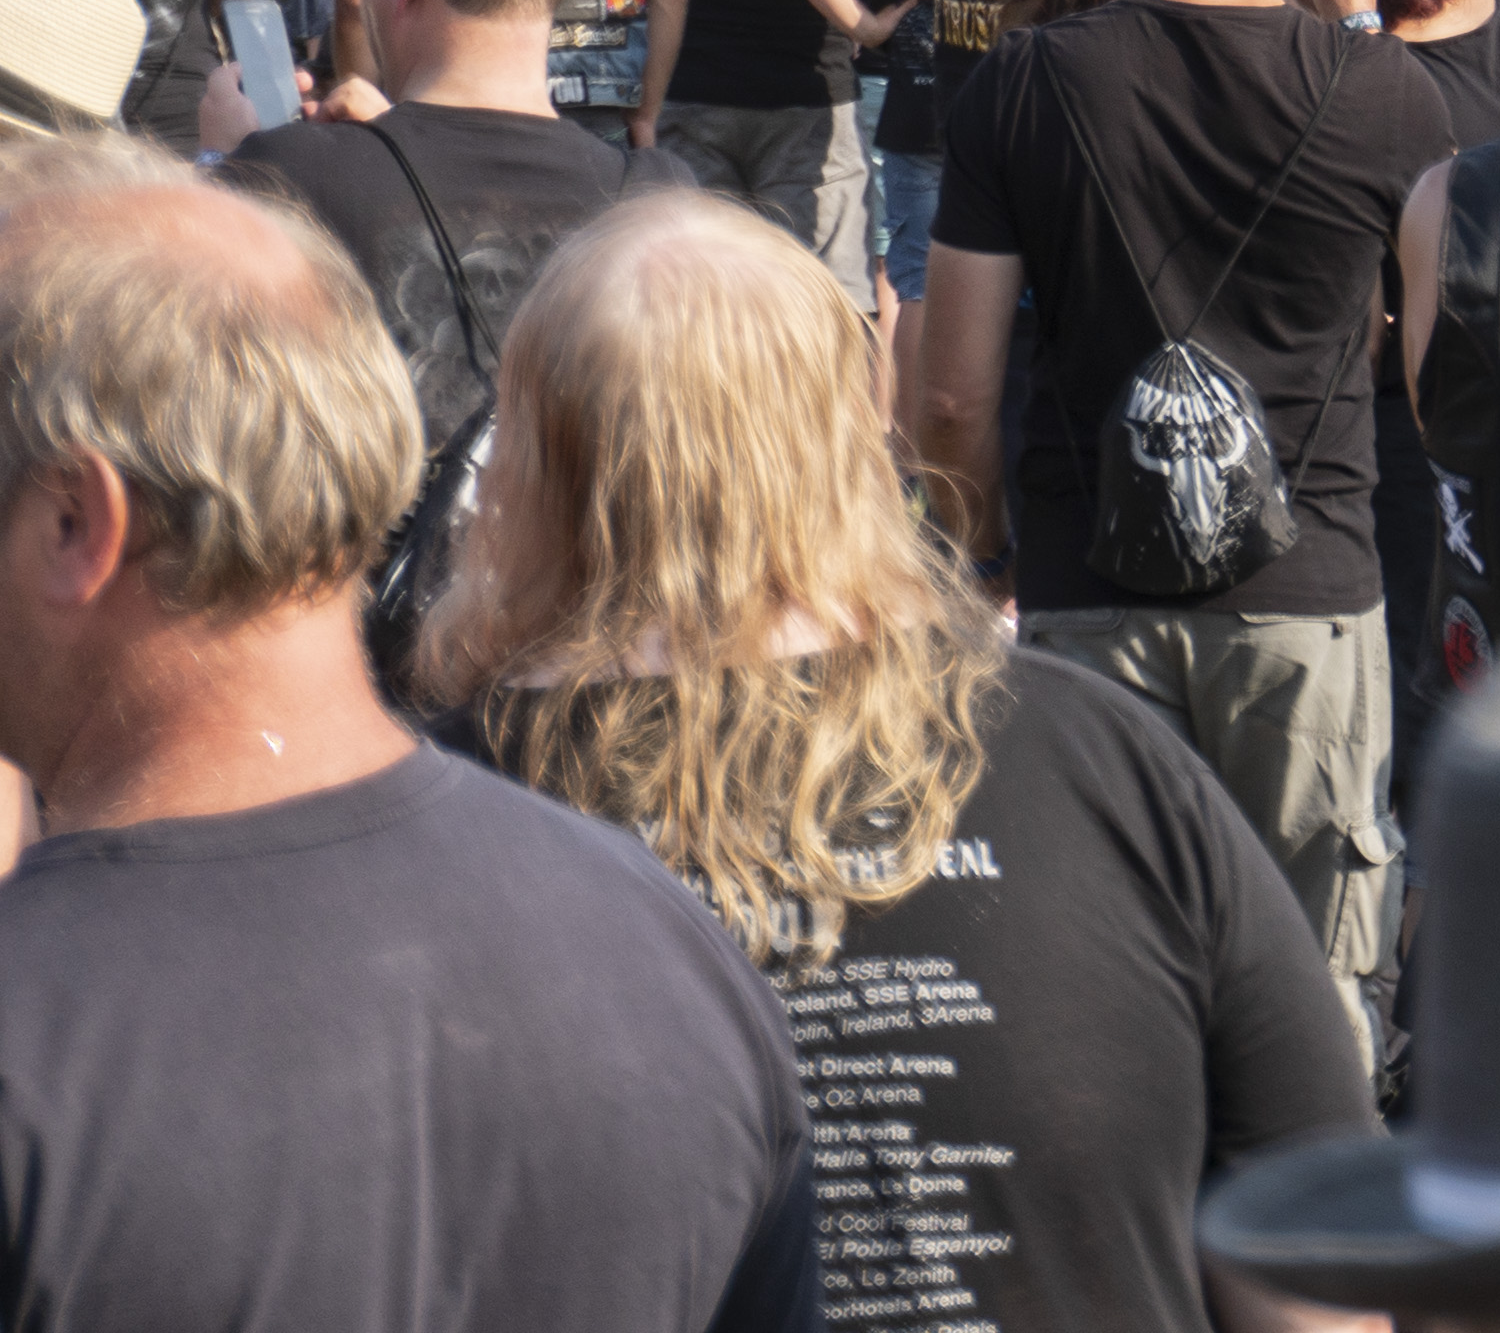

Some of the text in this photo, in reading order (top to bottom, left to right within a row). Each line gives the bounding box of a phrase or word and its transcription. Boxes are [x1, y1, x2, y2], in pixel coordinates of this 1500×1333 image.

[844, 961, 889, 983] SSE
[894, 958, 955, 983] Hydro
[864, 985, 909, 1005] SSE
[915, 981, 980, 1002] Arena
[920, 1003, 994, 1026] 3Arena
[820, 1057, 884, 1078] Direct
[889, 1055, 955, 1076] Arena
[860, 1086, 923, 1106] Arena
[813, 1145, 1015, 1170] Halle Tony Garnier
[816, 1176, 966, 1201] rance, Le Dome
[838, 1212, 969, 1233] Cool Festival
[841, 1239, 902, 1260] Poble
[909, 1233, 1012, 1259] Espanyol
[861, 1269, 887, 1288] Le
[892, 1265, 957, 1286] Zenith
[917, 1289, 974, 1312] Arena
